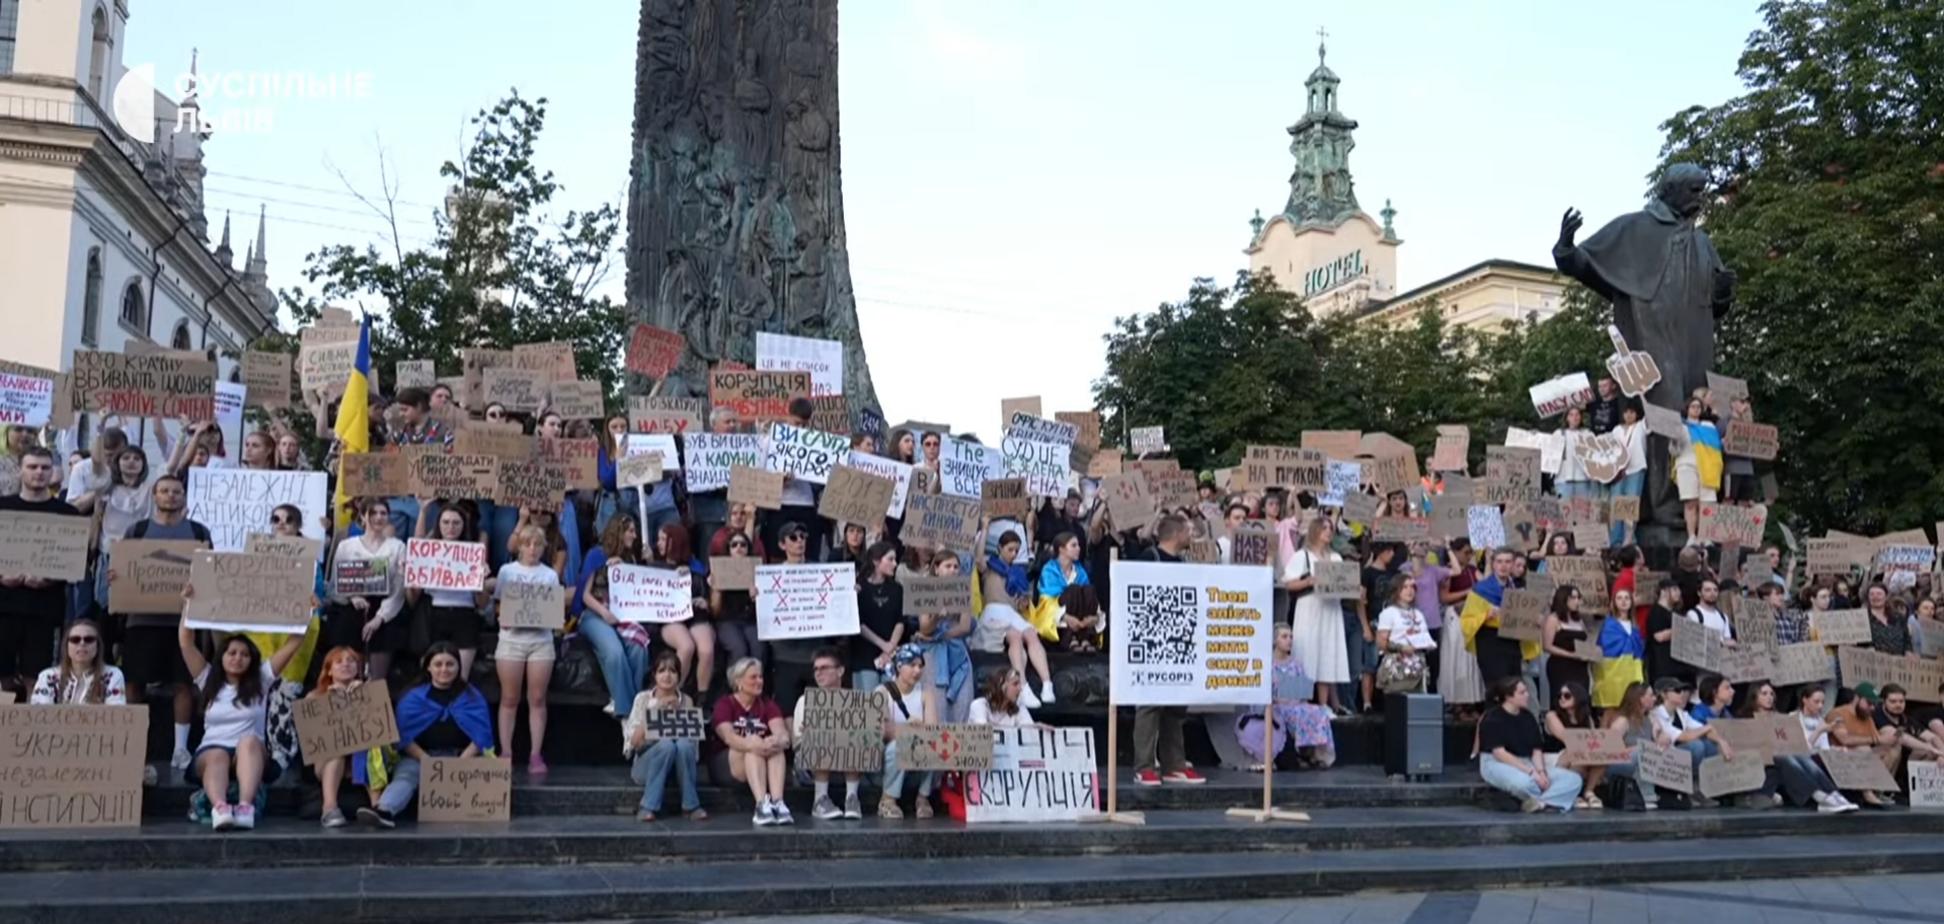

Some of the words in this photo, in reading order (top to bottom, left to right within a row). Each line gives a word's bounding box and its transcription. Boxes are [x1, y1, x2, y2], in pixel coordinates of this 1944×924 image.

[1305, 249, 1363, 296] HOTEL
[75, 350, 115, 369] МОЮ
[125, 355, 184, 371] КРАЇНУ
[74, 369, 156, 391] ВБИВАЮТЬ
[162, 374, 213, 395] ЩОДНЯ
[714, 373, 808, 392] КОРУПЦІЯ
[72, 393, 90, 413] ЦЕ
[95, 391, 158, 415] SENSITIVE
[162, 396, 214, 420] CONTENT
[772, 424, 798, 443] ВИ
[706, 451, 756, 467] КЛОУНИ
[951, 440, 984, 463] The
[1253, 448, 1269, 460] ВИ
[1274, 448, 1299, 460] ТАМ
[943, 458, 990, 481] ЗНИЩУЄ
[1248, 465, 1267, 483] НА
[1276, 465, 1324, 486] ПРИКОЛІ
[193, 473, 311, 502] НЕЗАЛЕЖНІ
[498, 473, 548, 488] СИСТЕМА
[835, 467, 888, 504] 2013
[954, 478, 981, 496] ВСЕ
[990, 481, 1022, 498] ЗМІНИ
[505, 485, 551, 501] ПРАЦЮЄ
[825, 496, 878, 520] ЗНОВУ
[1234, 534, 1268, 549] НАБУ
[409, 541, 485, 563] КОРУПЦІЯ
[1206, 586, 1249, 603] Твоя
[1206, 604, 1261, 621] злість
[1206, 623, 1255, 637] може
[1206, 641, 1249, 654] мати
[1206, 658, 1249, 672] силу
[1252, 658, 1262, 670] в
[1147, 671, 1194, 683] РУСОРІЗ
[1205, 674, 1261, 690] донаті
[805, 689, 884, 708] ПОТУЖНО
[301, 699, 321, 720] НЕ
[803, 709, 868, 730] БОРЕМОСЯ
[11, 731, 130, 758] УКРАЇНІ
[800, 745, 883, 771] КОРУПЦІЄЮ
[430, 760, 443, 782] Я
